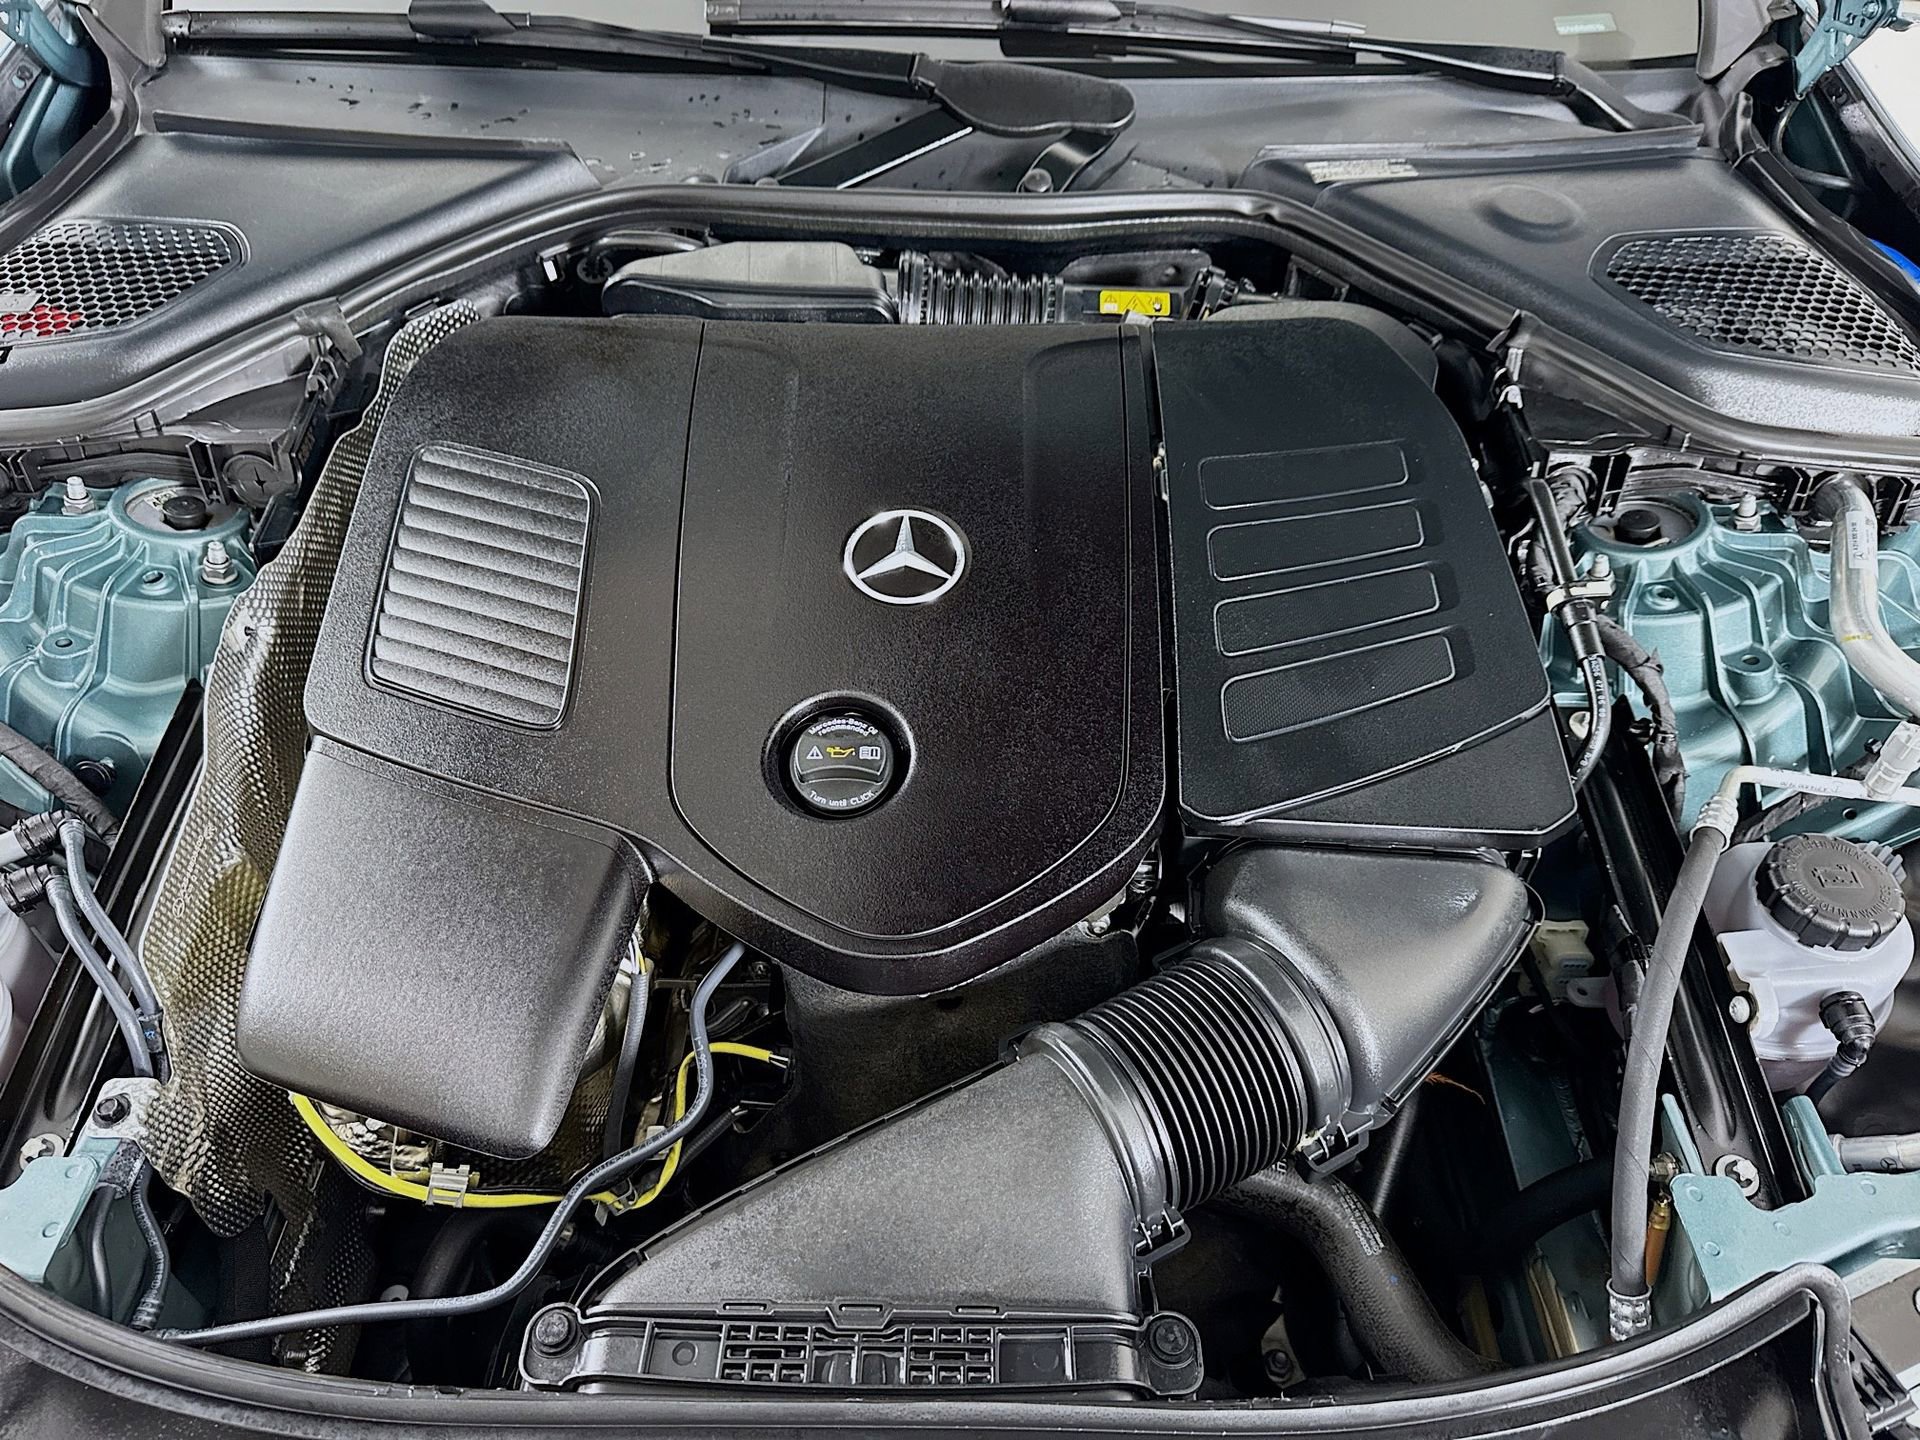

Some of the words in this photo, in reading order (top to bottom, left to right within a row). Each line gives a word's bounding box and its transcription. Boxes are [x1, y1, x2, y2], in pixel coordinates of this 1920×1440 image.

[818, 724, 869, 736] recommended
[809, 790, 827, 804] Turn
[829, 799, 847, 807] until
[850, 790, 874, 804] CLICK
